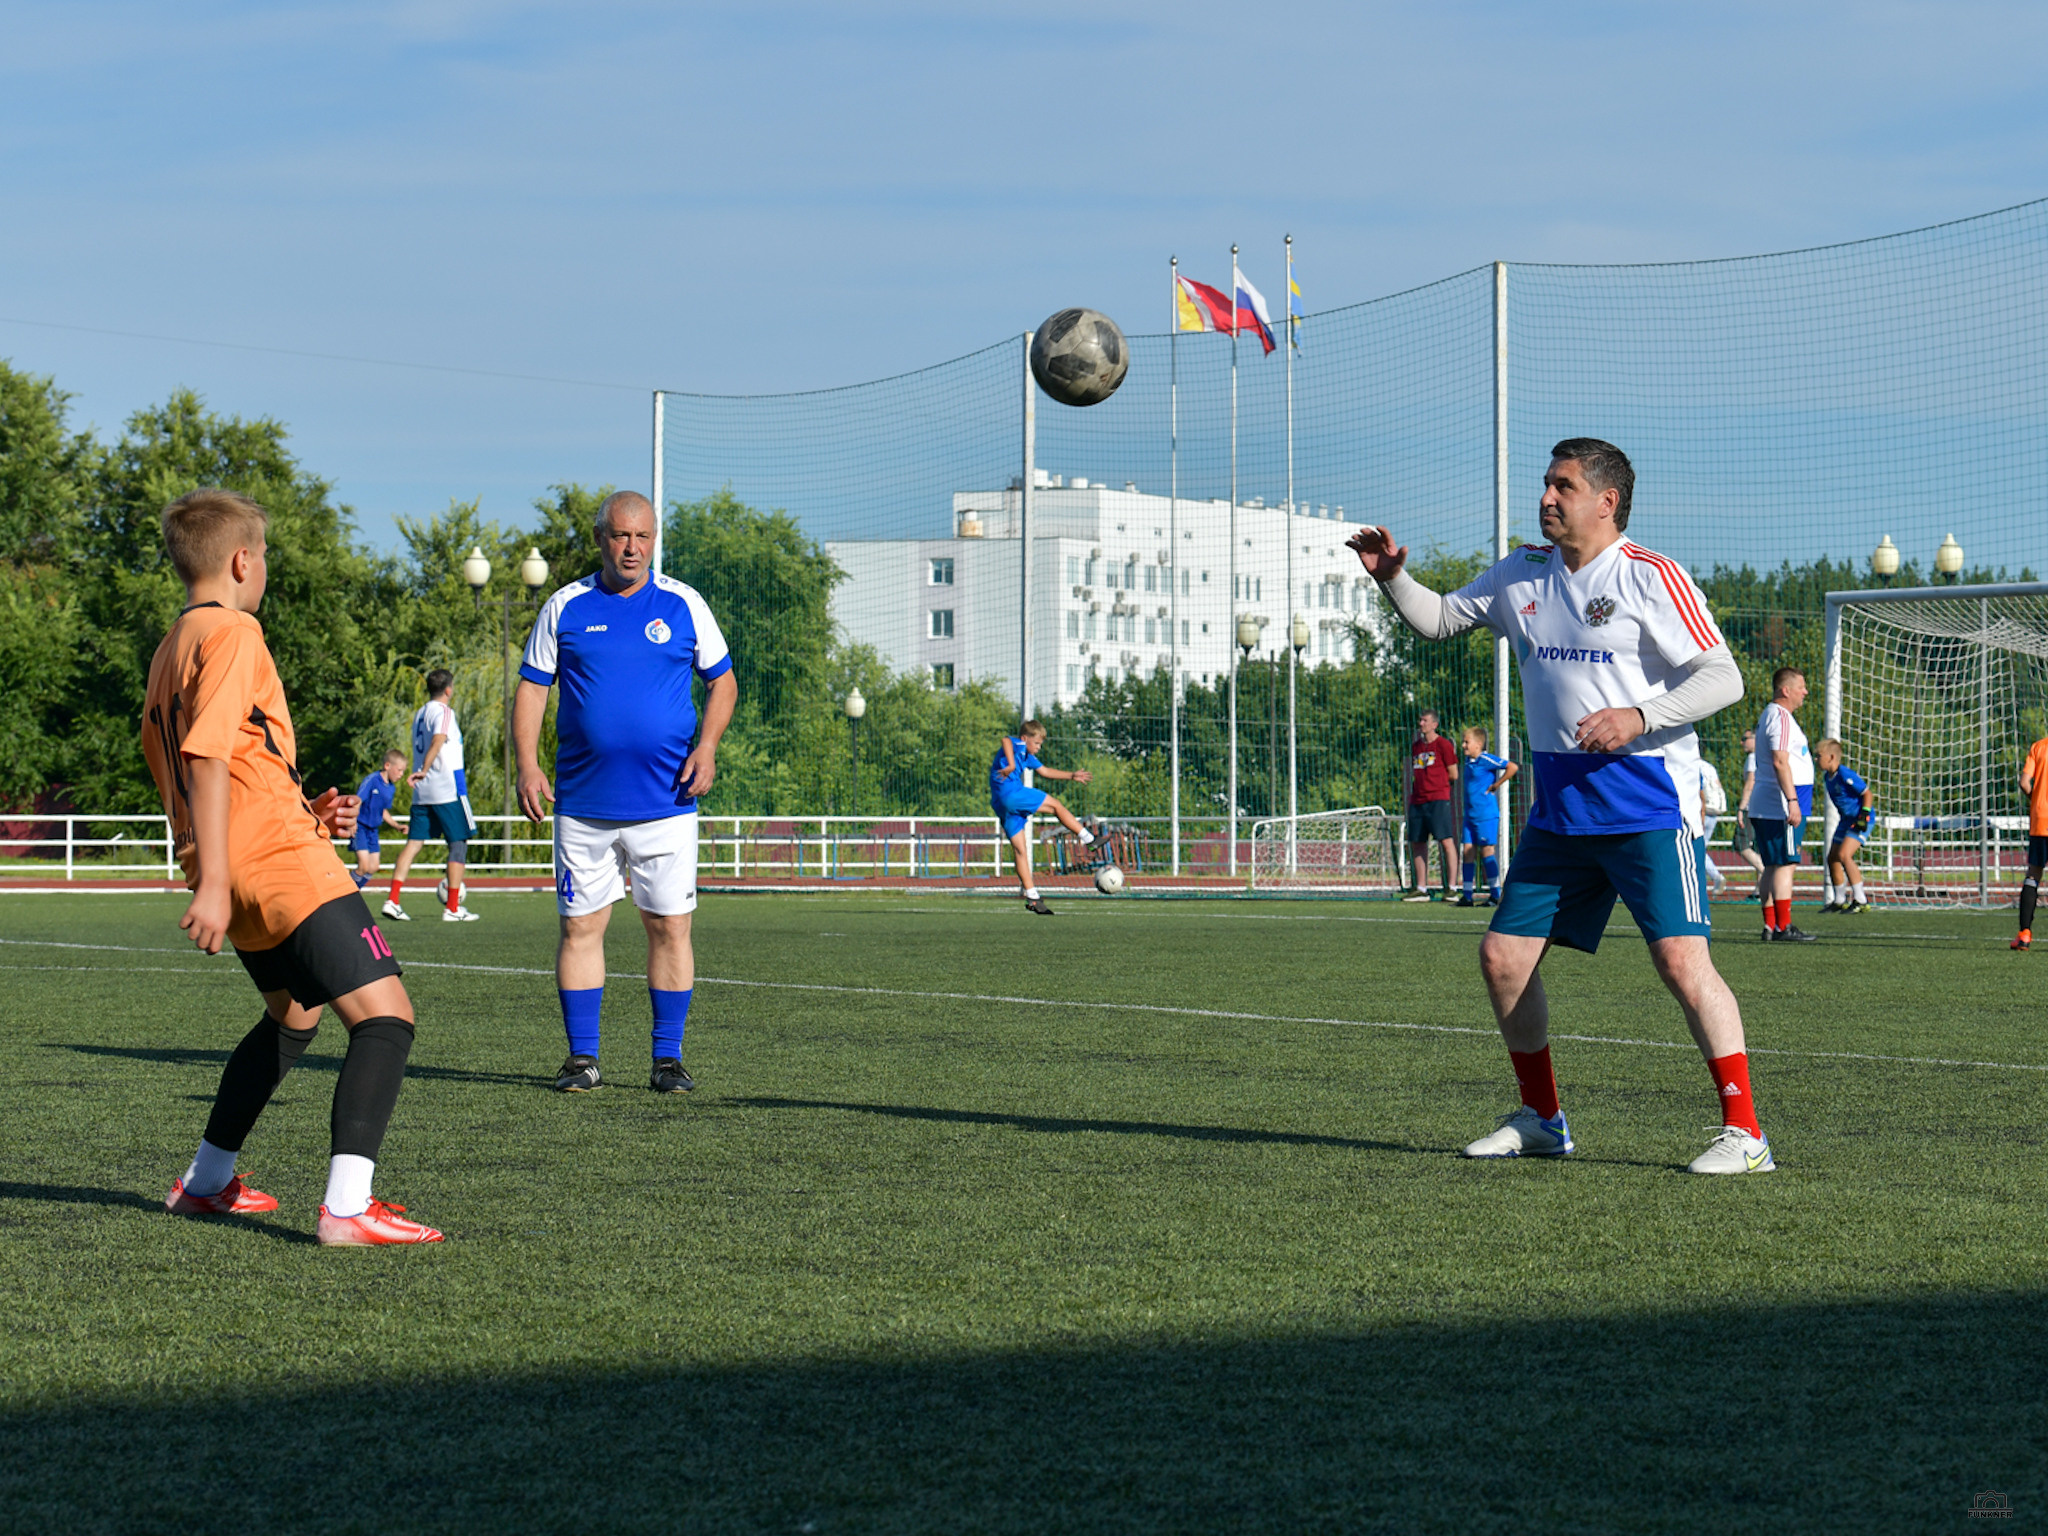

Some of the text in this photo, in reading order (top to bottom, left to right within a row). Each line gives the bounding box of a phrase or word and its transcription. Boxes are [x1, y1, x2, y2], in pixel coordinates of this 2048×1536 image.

[1537, 646, 1614, 664] NOVATEK
[416, 718, 424, 754] 5
[360, 925, 392, 960] 10
